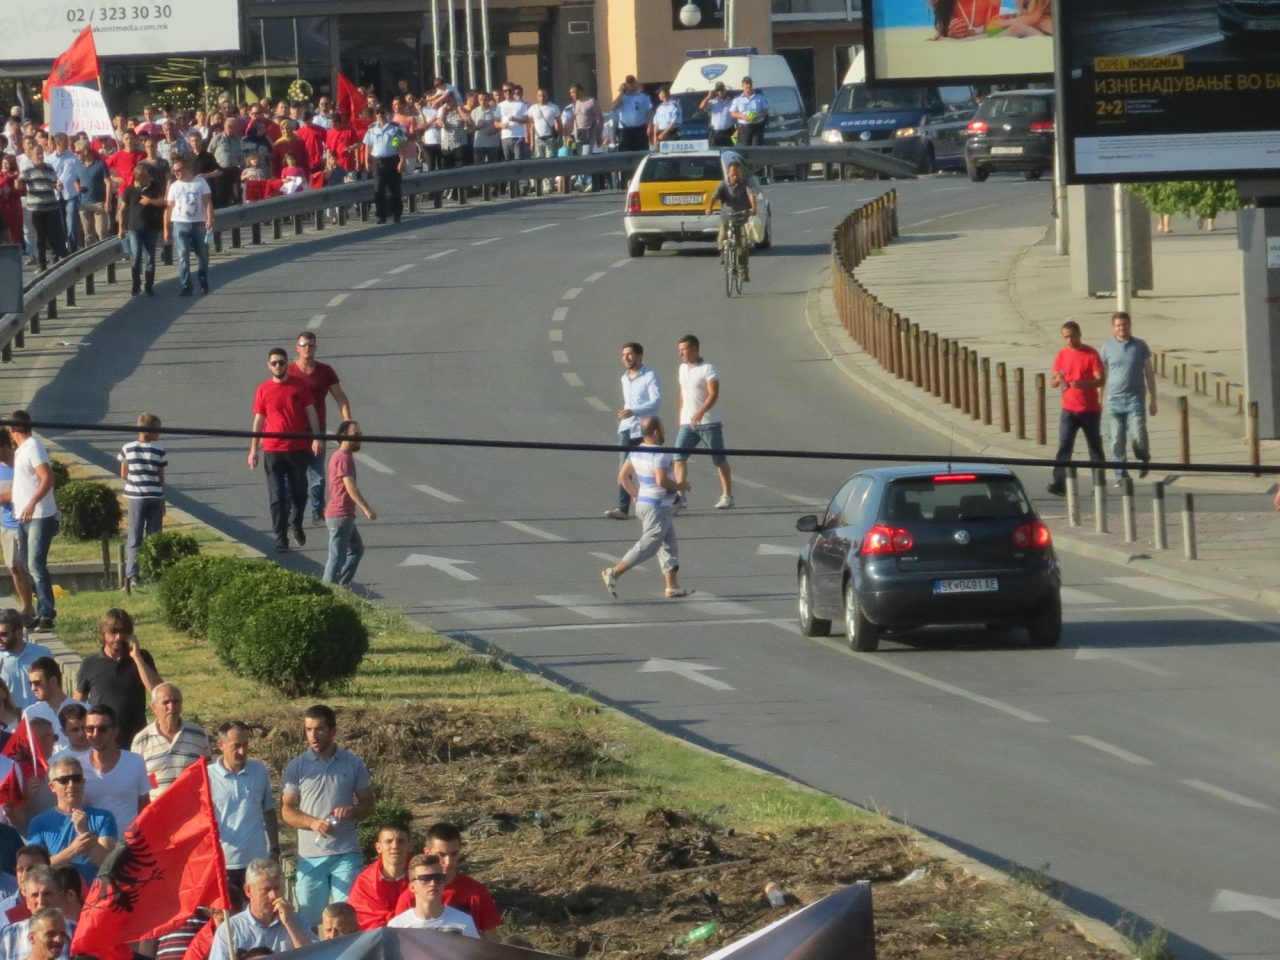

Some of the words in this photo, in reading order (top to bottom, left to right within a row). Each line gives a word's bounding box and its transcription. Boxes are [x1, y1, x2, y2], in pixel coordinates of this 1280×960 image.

[66, 9, 85, 22] 02
[100, 7, 126, 20] 323
[131, 6, 149, 19] 30
[153, 5, 172, 18] 30
[1128, 56, 1180, 69] INSIGNIA
[1094, 75, 1233, 95] ИЗНЕНАДУВАЊЕ
[1237, 74, 1262, 89] ВО
[1096, 101, 1123, 114] 2+2
